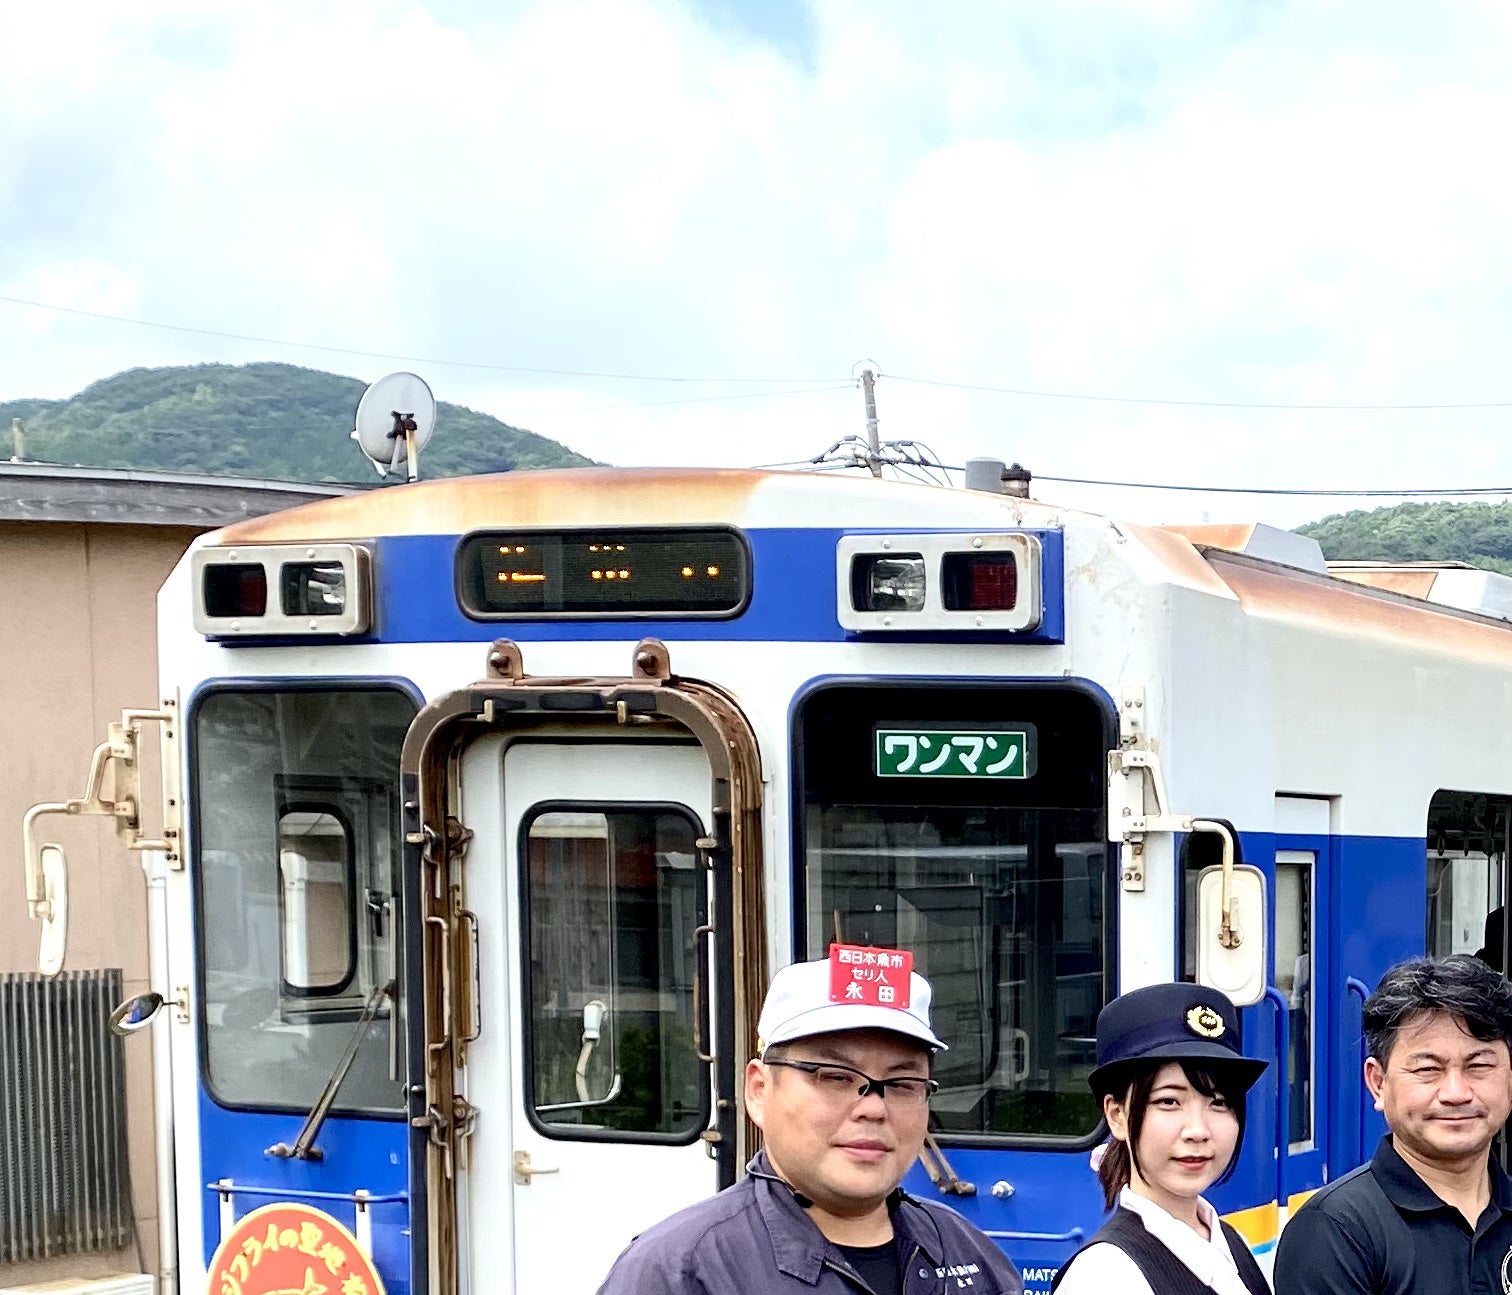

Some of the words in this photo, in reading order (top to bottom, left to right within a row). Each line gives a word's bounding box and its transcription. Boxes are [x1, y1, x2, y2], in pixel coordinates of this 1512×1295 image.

[885, 735, 1018, 774] ワンマン
[838, 949, 904, 969] 西日本魚市
[851, 966, 889, 984] セリ人
